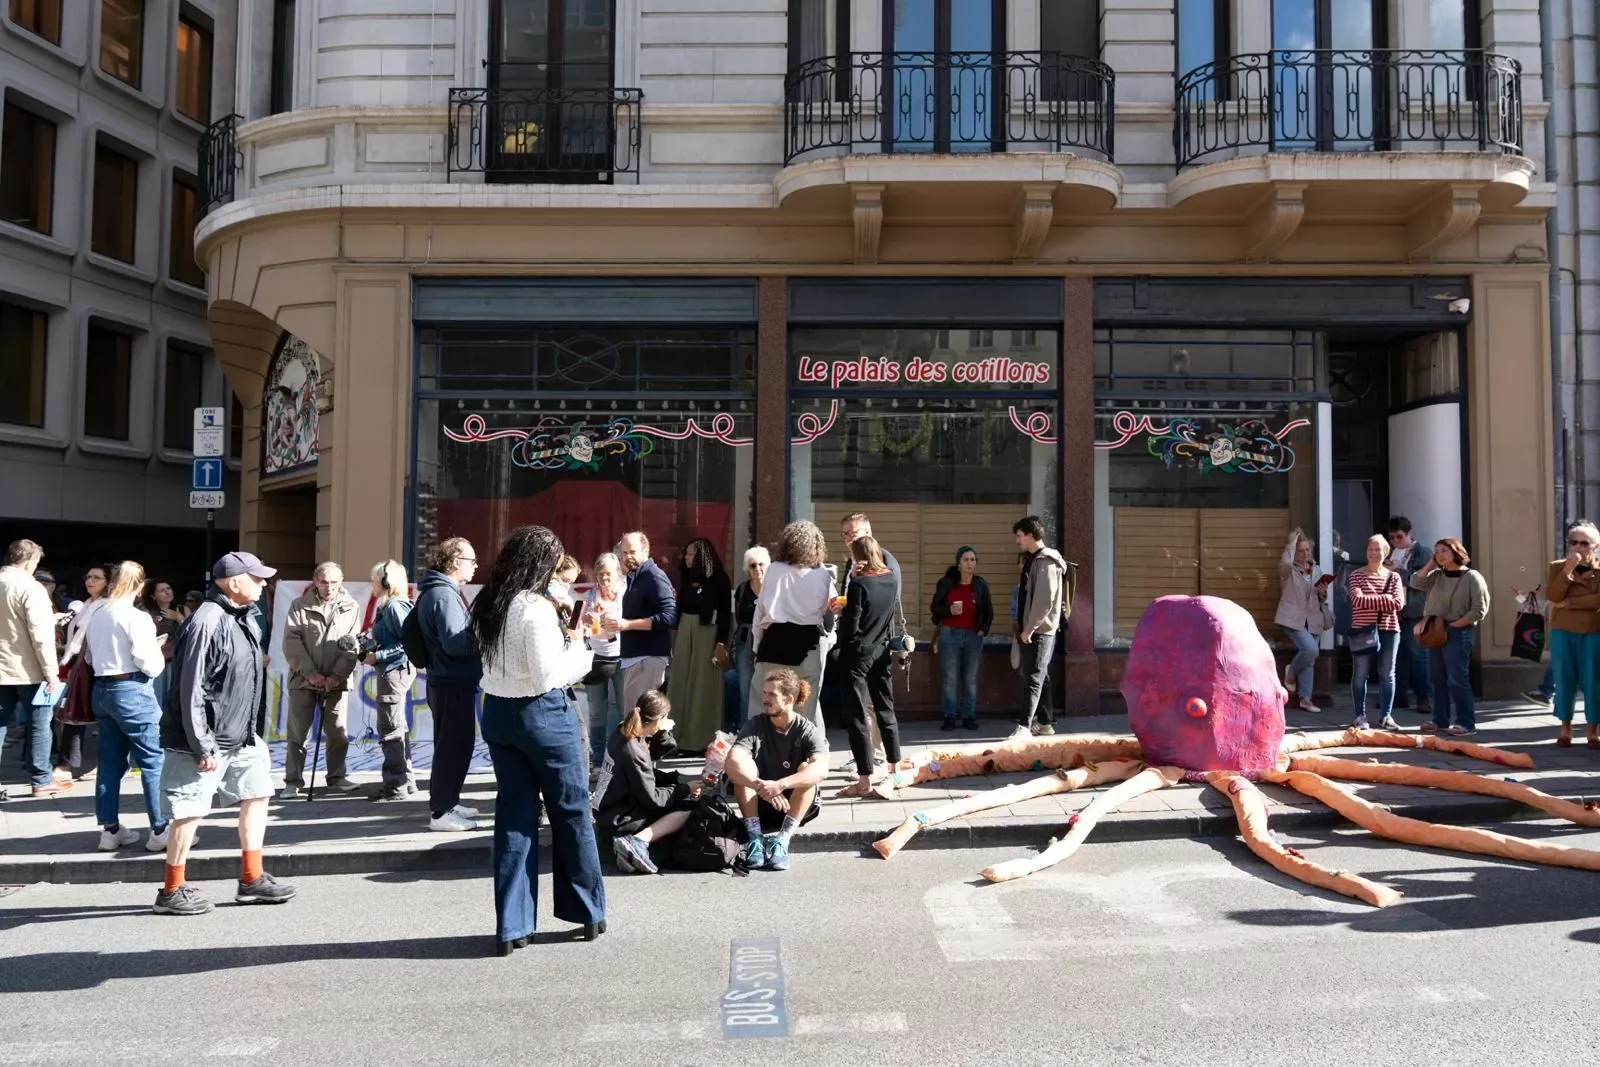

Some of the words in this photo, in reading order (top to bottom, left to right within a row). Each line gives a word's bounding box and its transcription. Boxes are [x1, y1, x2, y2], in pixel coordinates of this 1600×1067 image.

[799, 356, 828, 381] Le
[831, 356, 899, 389] palais
[905, 356, 946, 382] des
[952, 357, 1050, 382] cotillons
